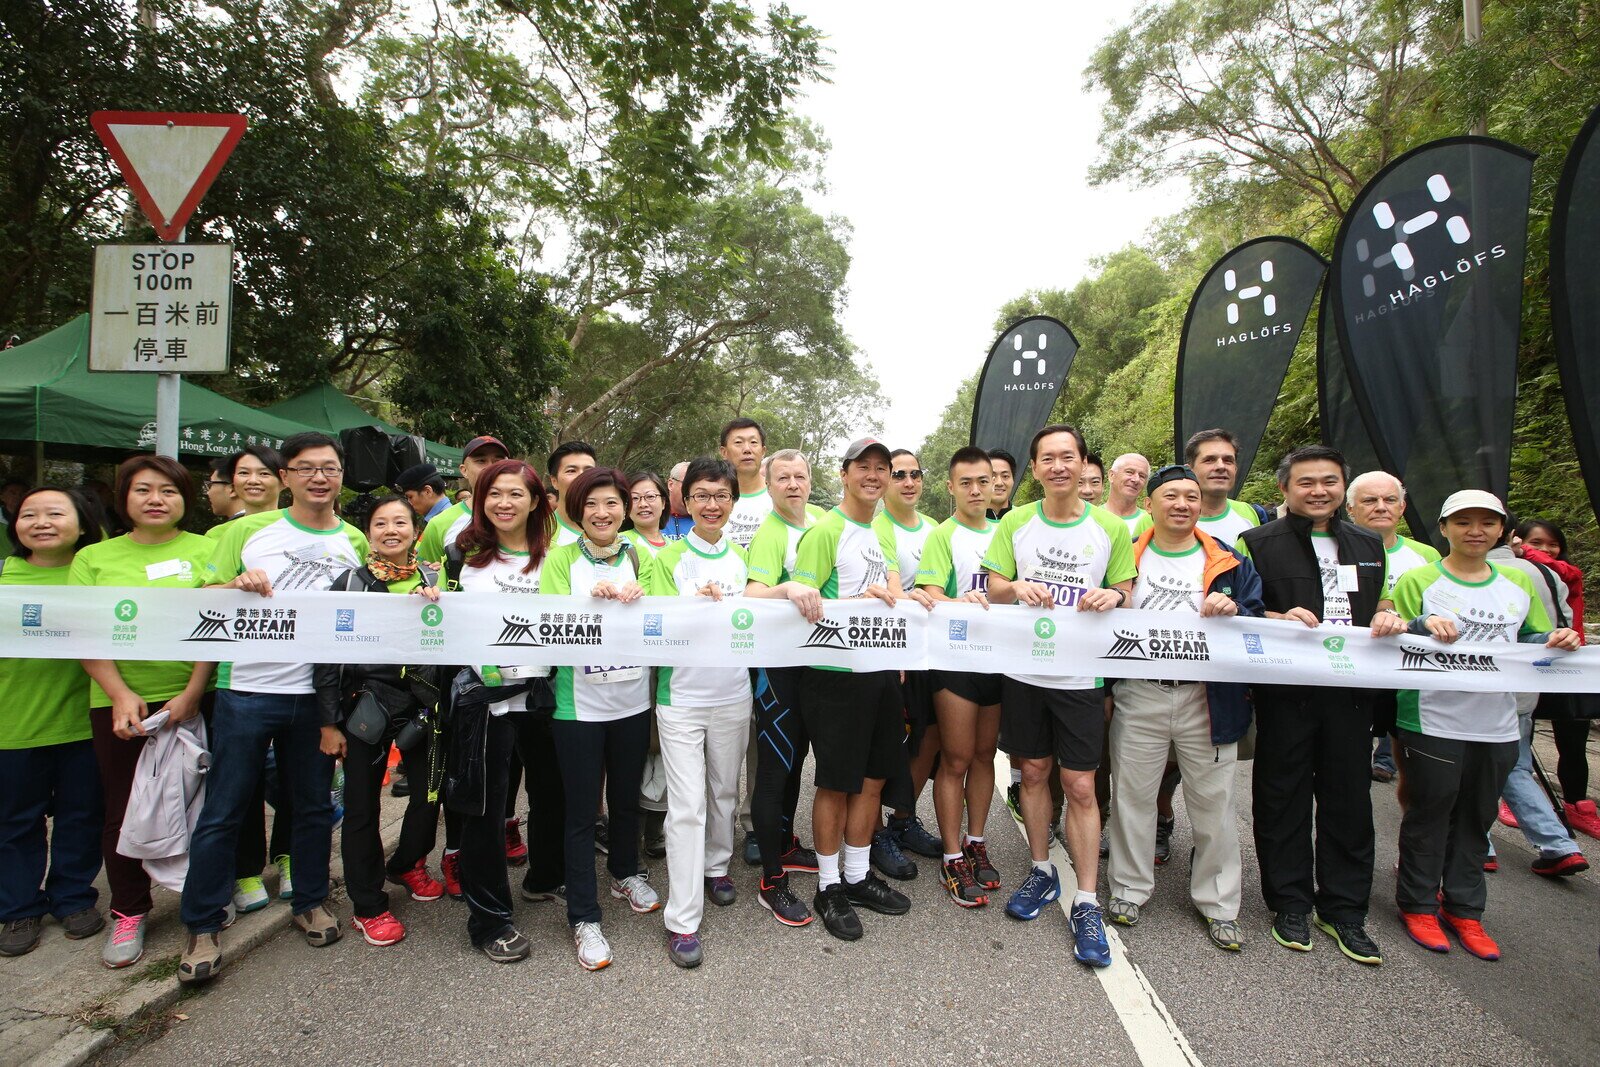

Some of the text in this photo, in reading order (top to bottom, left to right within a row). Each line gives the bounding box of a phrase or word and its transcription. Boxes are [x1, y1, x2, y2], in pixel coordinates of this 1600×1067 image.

[132, 252, 195, 271] STOP
[1389, 244, 1506, 305] HAGLÖFS
[133, 274, 193, 291] 100m
[104, 301, 219, 326] 一百米前
[1216, 323, 1292, 347] HAGLÖFS
[133, 337, 188, 362] 停車
[1004, 382, 1054, 391] HAGLÖFS
[180, 440, 205, 453] Hong
[206, 443, 228, 455] Kong
[1062, 574, 1084, 585] 2014
[236, 608, 297, 619] 樂施毅行者
[540, 612, 603, 624] 樂施毅行者
[233, 619, 295, 632] OXFAM
[848, 616, 907, 627] 樂施毅行者
[22, 629, 70, 637] STATE STREET
[233, 632, 295, 640] TRAILWALKER
[538, 624, 602, 637] OXFAM
[847, 627, 907, 641] OXFAM
[1148, 629, 1206, 641] 樂施毅行者
[540, 637, 602, 645] TRAILWALKER
[848, 640, 907, 649] TRAILWALKER
[949, 642, 992, 652] STATE STREET
[1148, 639, 1209, 653] OXFAM
[1149, 652, 1210, 661] TRAILWALKER
[1434, 652, 1495, 666] OXFAM
[1440, 664, 1500, 672] TRAILWALKER
